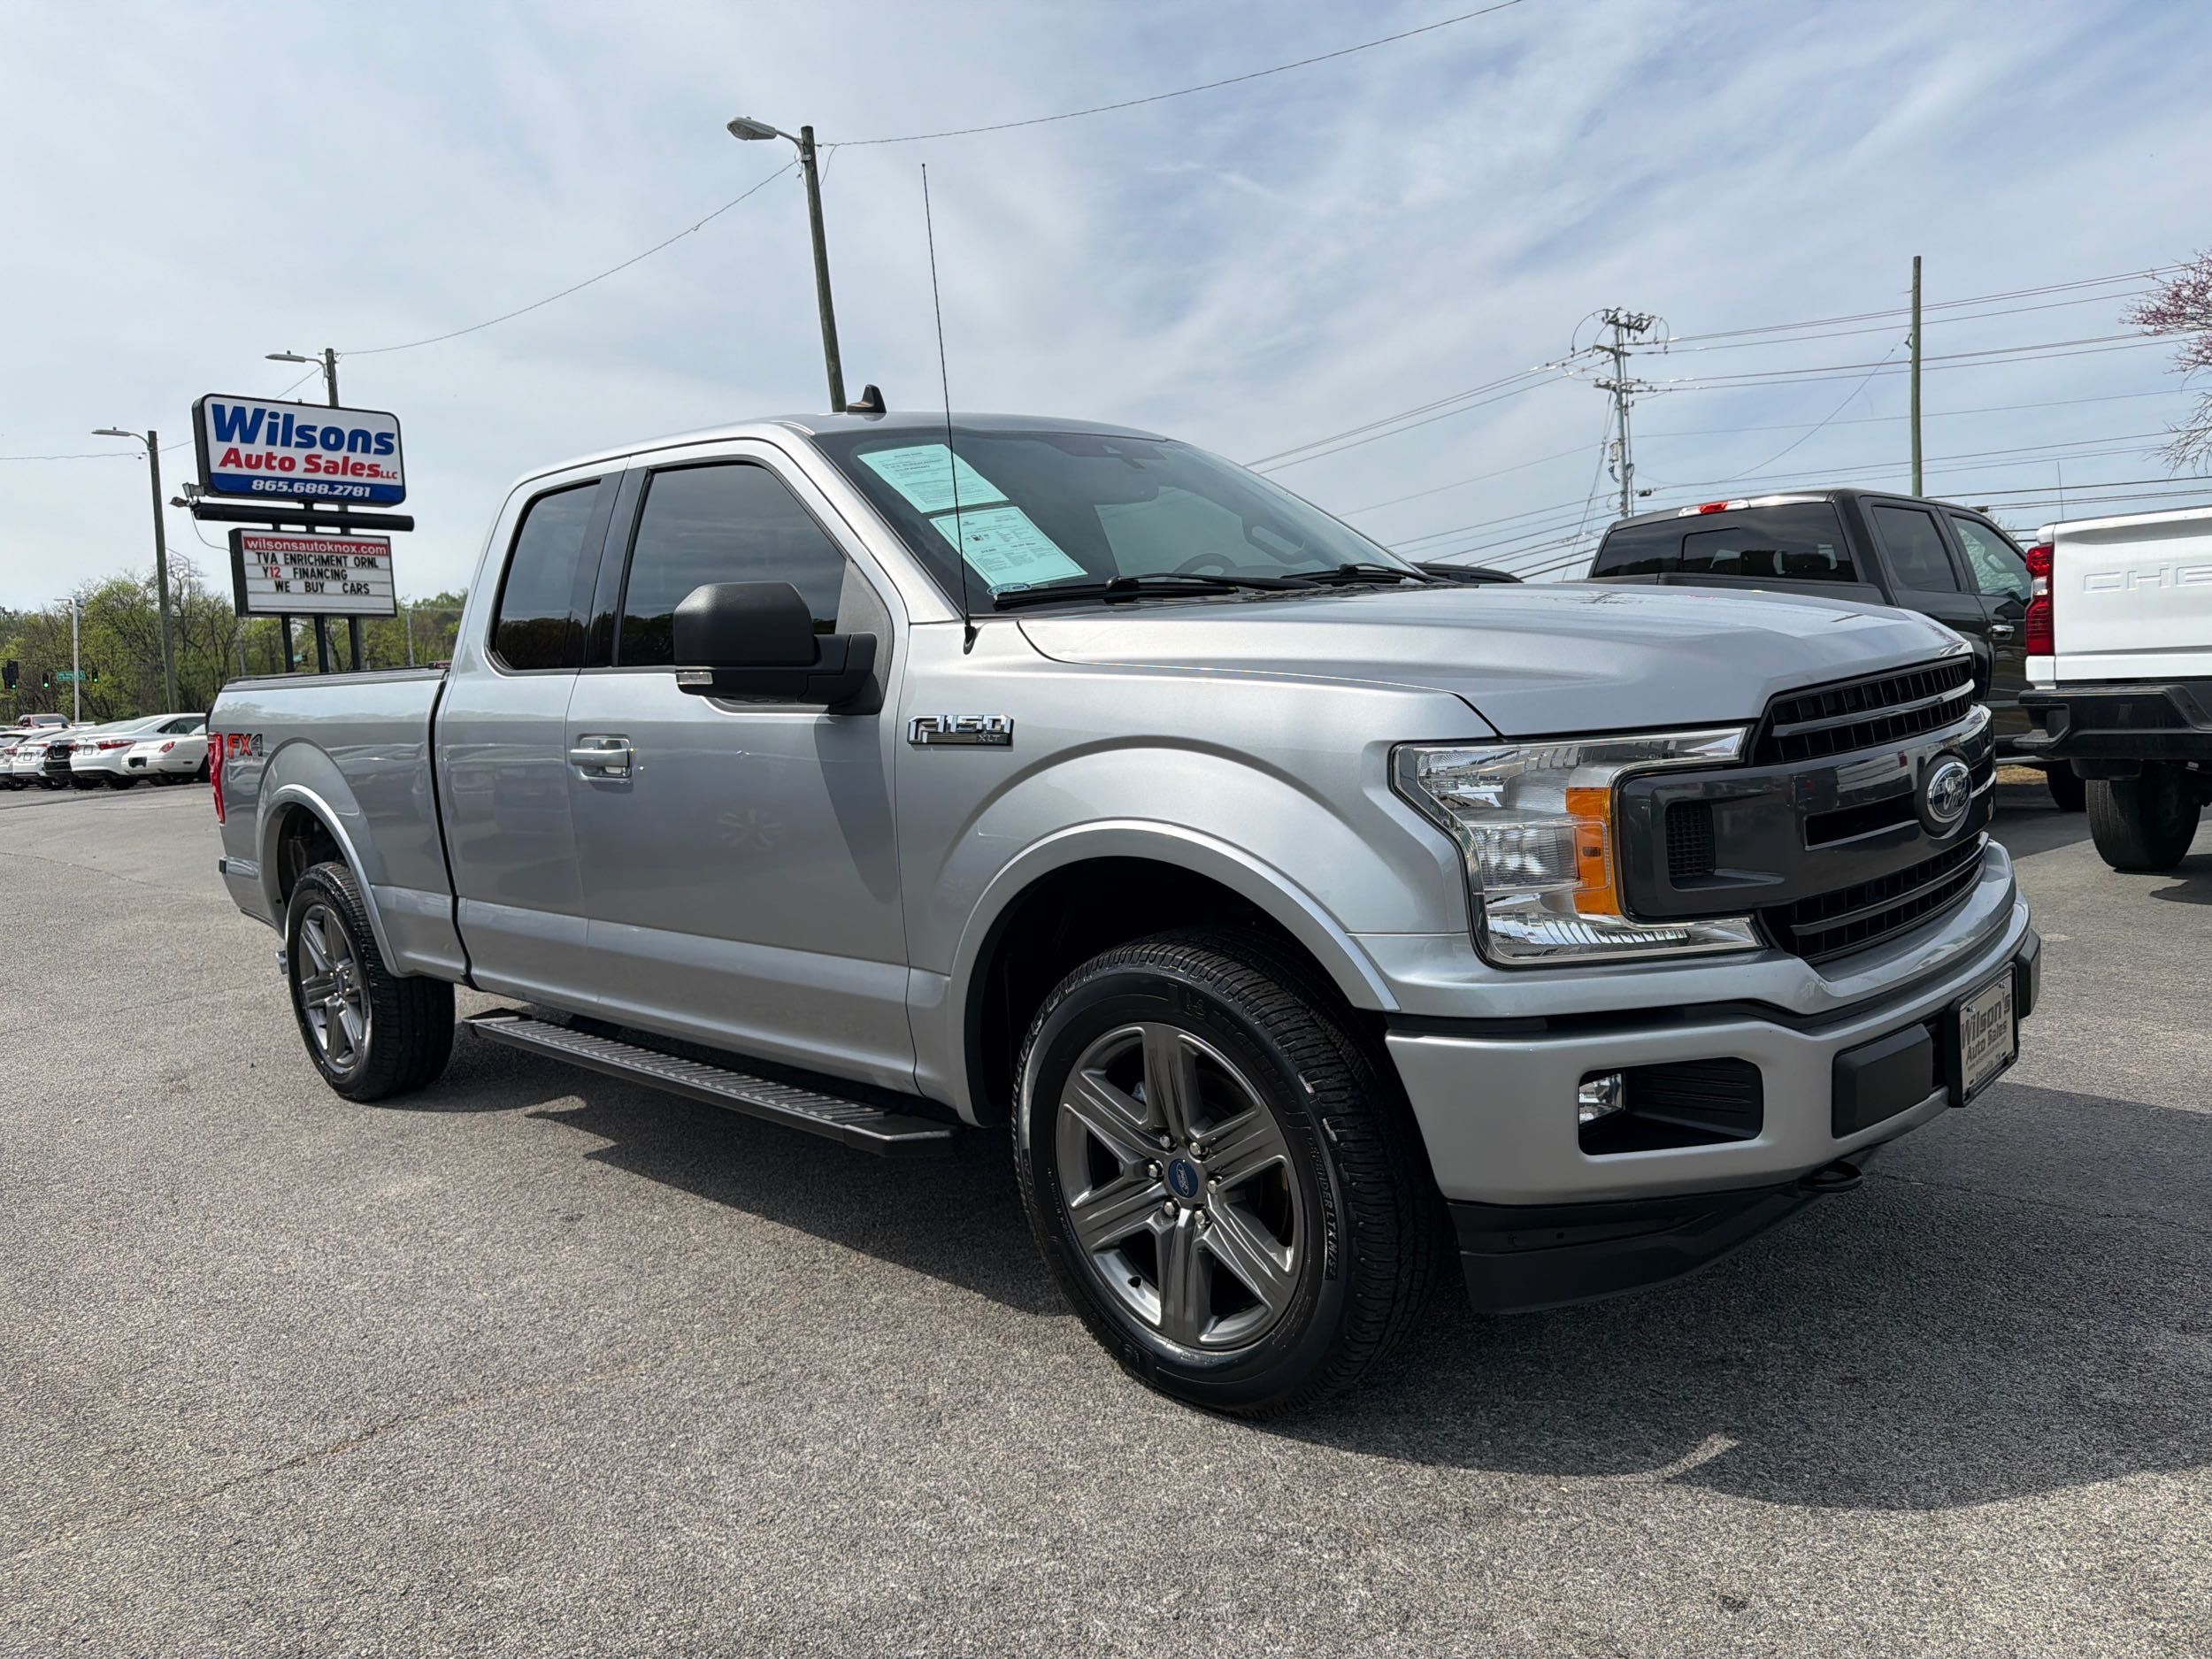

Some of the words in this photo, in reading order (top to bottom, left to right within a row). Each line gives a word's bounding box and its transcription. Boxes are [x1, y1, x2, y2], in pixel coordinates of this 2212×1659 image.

[211, 403, 395, 456] Wilsons
[219, 448, 296, 472] Auto
[303, 454, 380, 478] Sales
[380, 471, 398, 480] LLC
[251, 479, 372, 497] 865.688.2781
[247, 539, 387, 555] wilsonsautoknox.com
[256, 552, 278, 565] TVA
[283, 554, 349, 566] ENRICHMENT
[354, 557, 379, 568] ORNL
[262, 566, 281, 578] Y12
[293, 567, 349, 580] FINANCING
[274, 580, 291, 592] WE
[304, 582, 325, 593] BUY
[342, 583, 370, 594] CARS
[227, 733, 264, 759] FX4
[1962, 991, 2011, 1050] Wilson's
[1966, 1039, 1986, 1064] Auto
[1987, 1020, 2007, 1046] Sales
